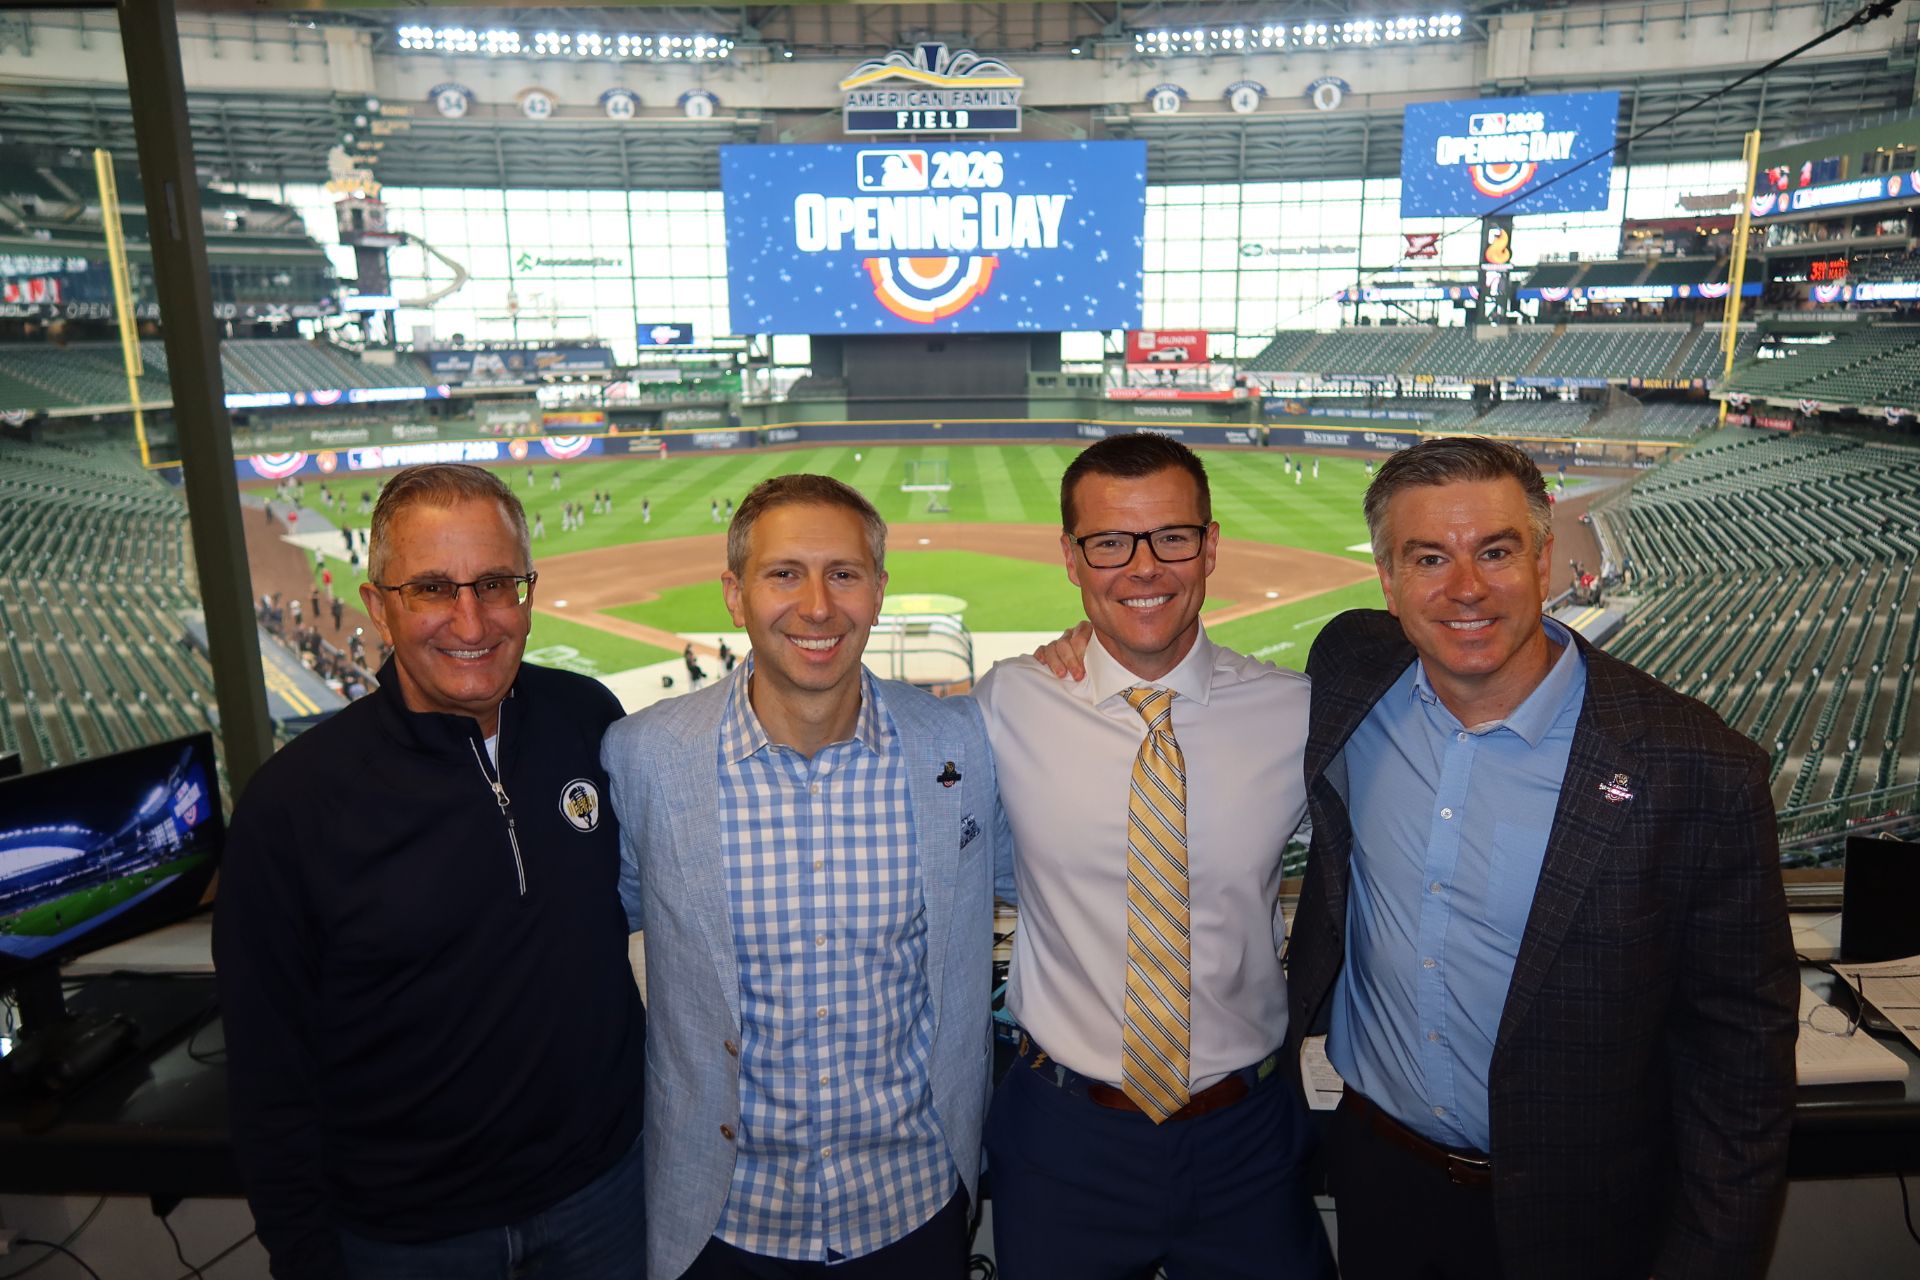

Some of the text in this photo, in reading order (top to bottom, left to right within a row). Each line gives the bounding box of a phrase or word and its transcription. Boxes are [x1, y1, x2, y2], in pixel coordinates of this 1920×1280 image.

[848, 91, 1020, 107] AMERICAN FAMILY
[896, 110, 969, 129] FIELD
[1436, 131, 1576, 166] OPENING DAY
[930, 150, 1004, 189] 2026
[794, 192, 1067, 252] OPENING DAY
[67, 302, 112, 319] OPEN
[1133, 406, 1193, 417] TOYOTA.COM
[1303, 430, 1350, 446] WINTRUST
